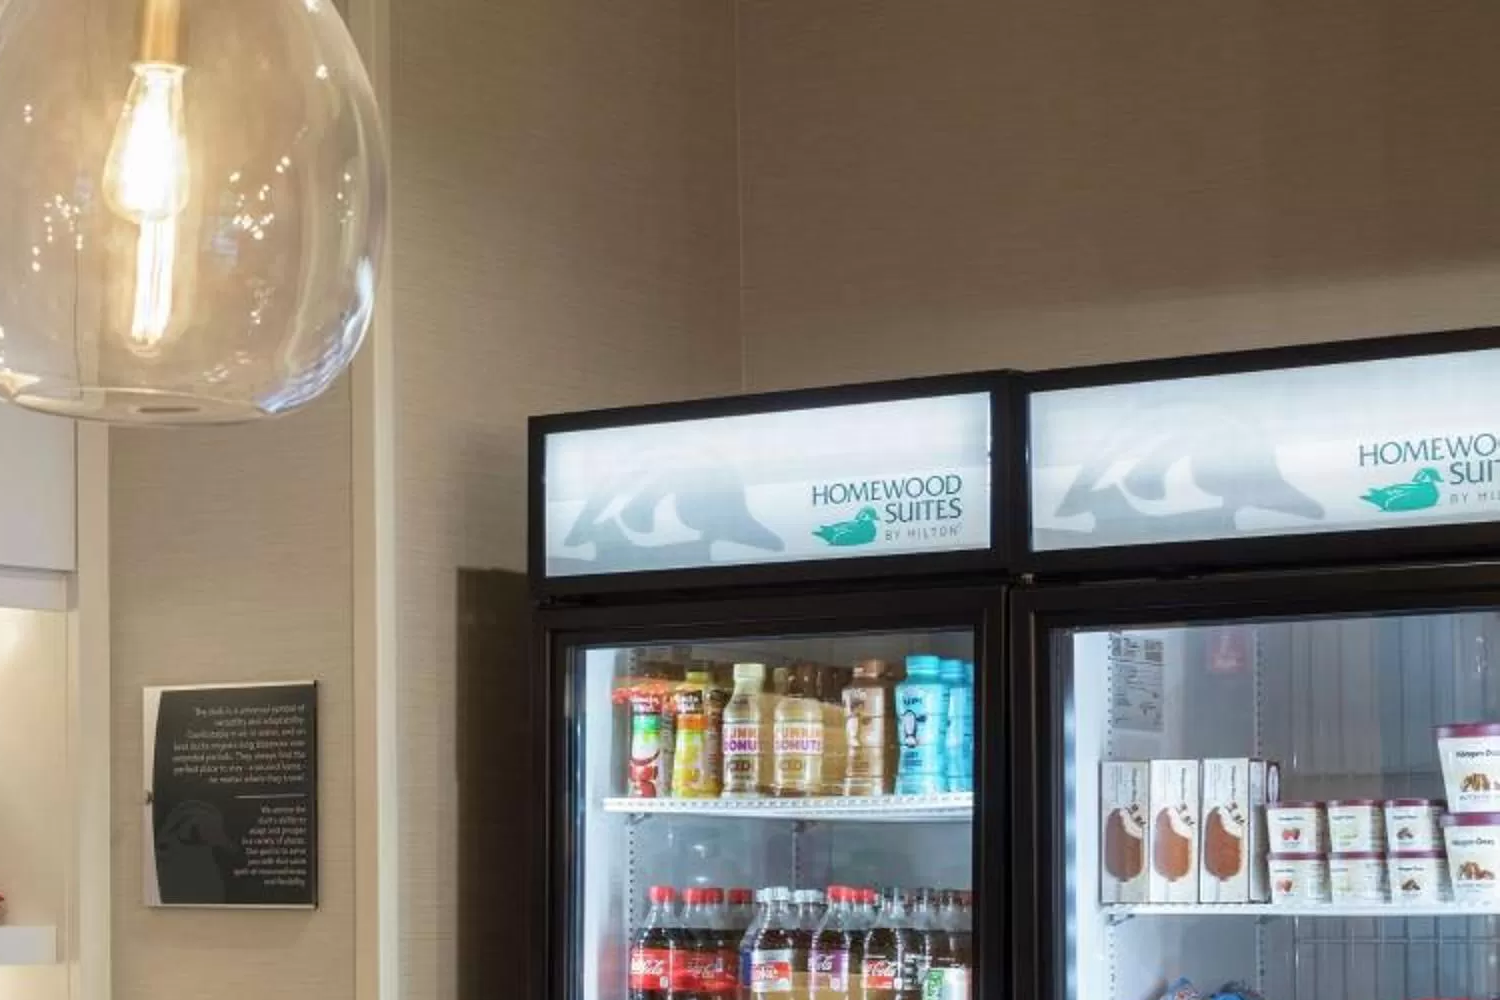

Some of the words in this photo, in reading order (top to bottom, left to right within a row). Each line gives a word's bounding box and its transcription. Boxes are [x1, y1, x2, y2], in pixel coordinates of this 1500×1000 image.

[1358, 433, 1500, 467] HOMEWO
[812, 474, 963, 507] HOMEWOOD
[884, 497, 963, 525] SUITES
[885, 530, 900, 541] BY
[907, 525, 960, 539] HILTON
